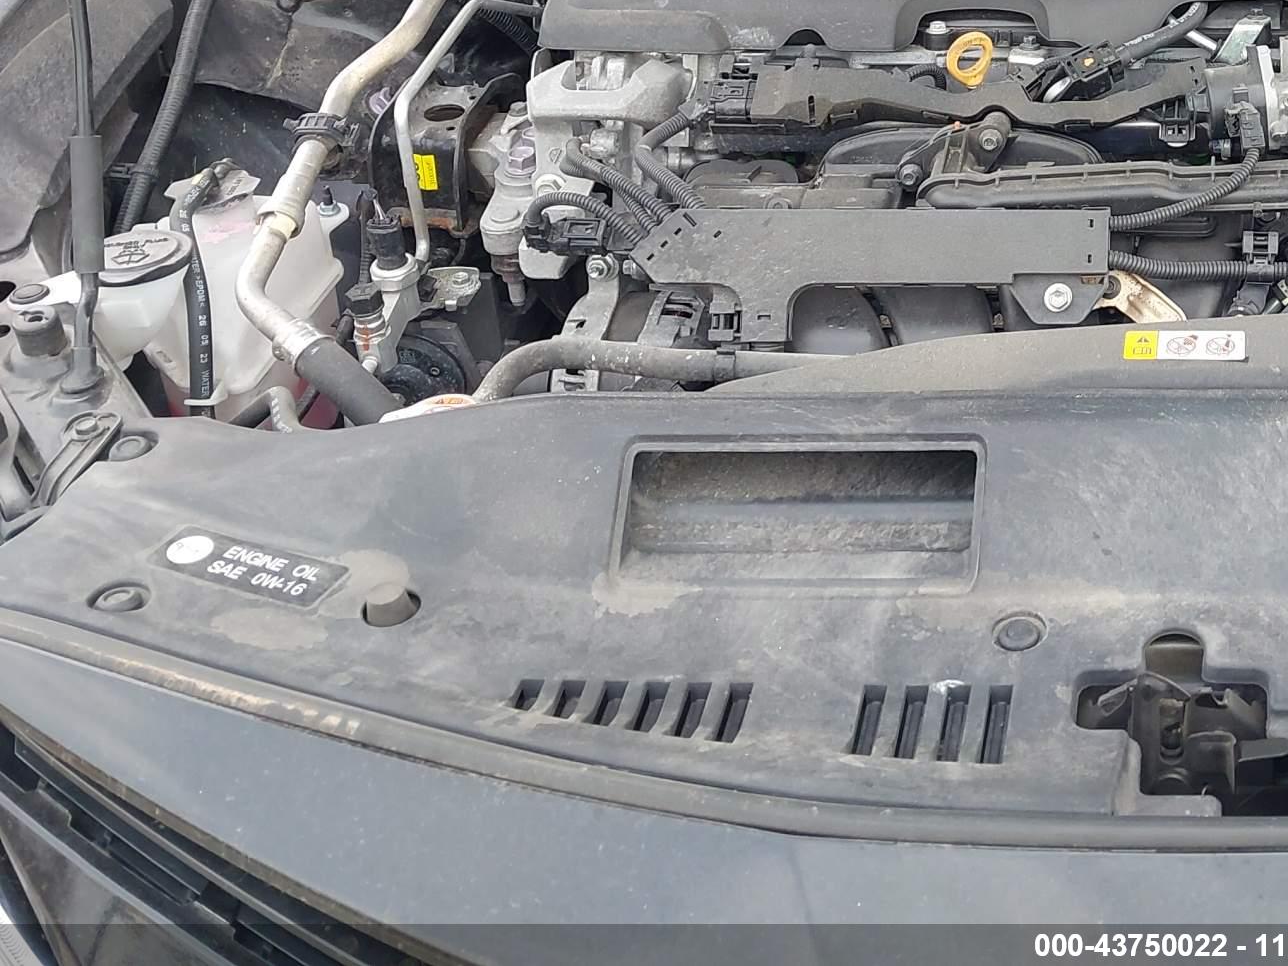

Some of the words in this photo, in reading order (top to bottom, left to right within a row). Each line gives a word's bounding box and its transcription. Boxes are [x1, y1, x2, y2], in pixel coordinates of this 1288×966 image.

[207, 560, 247, 580] SAE
[250, 572, 307, 596] 0W-16
[223, 546, 289, 572] ENGINE
[292, 565, 320, 581] OIL
